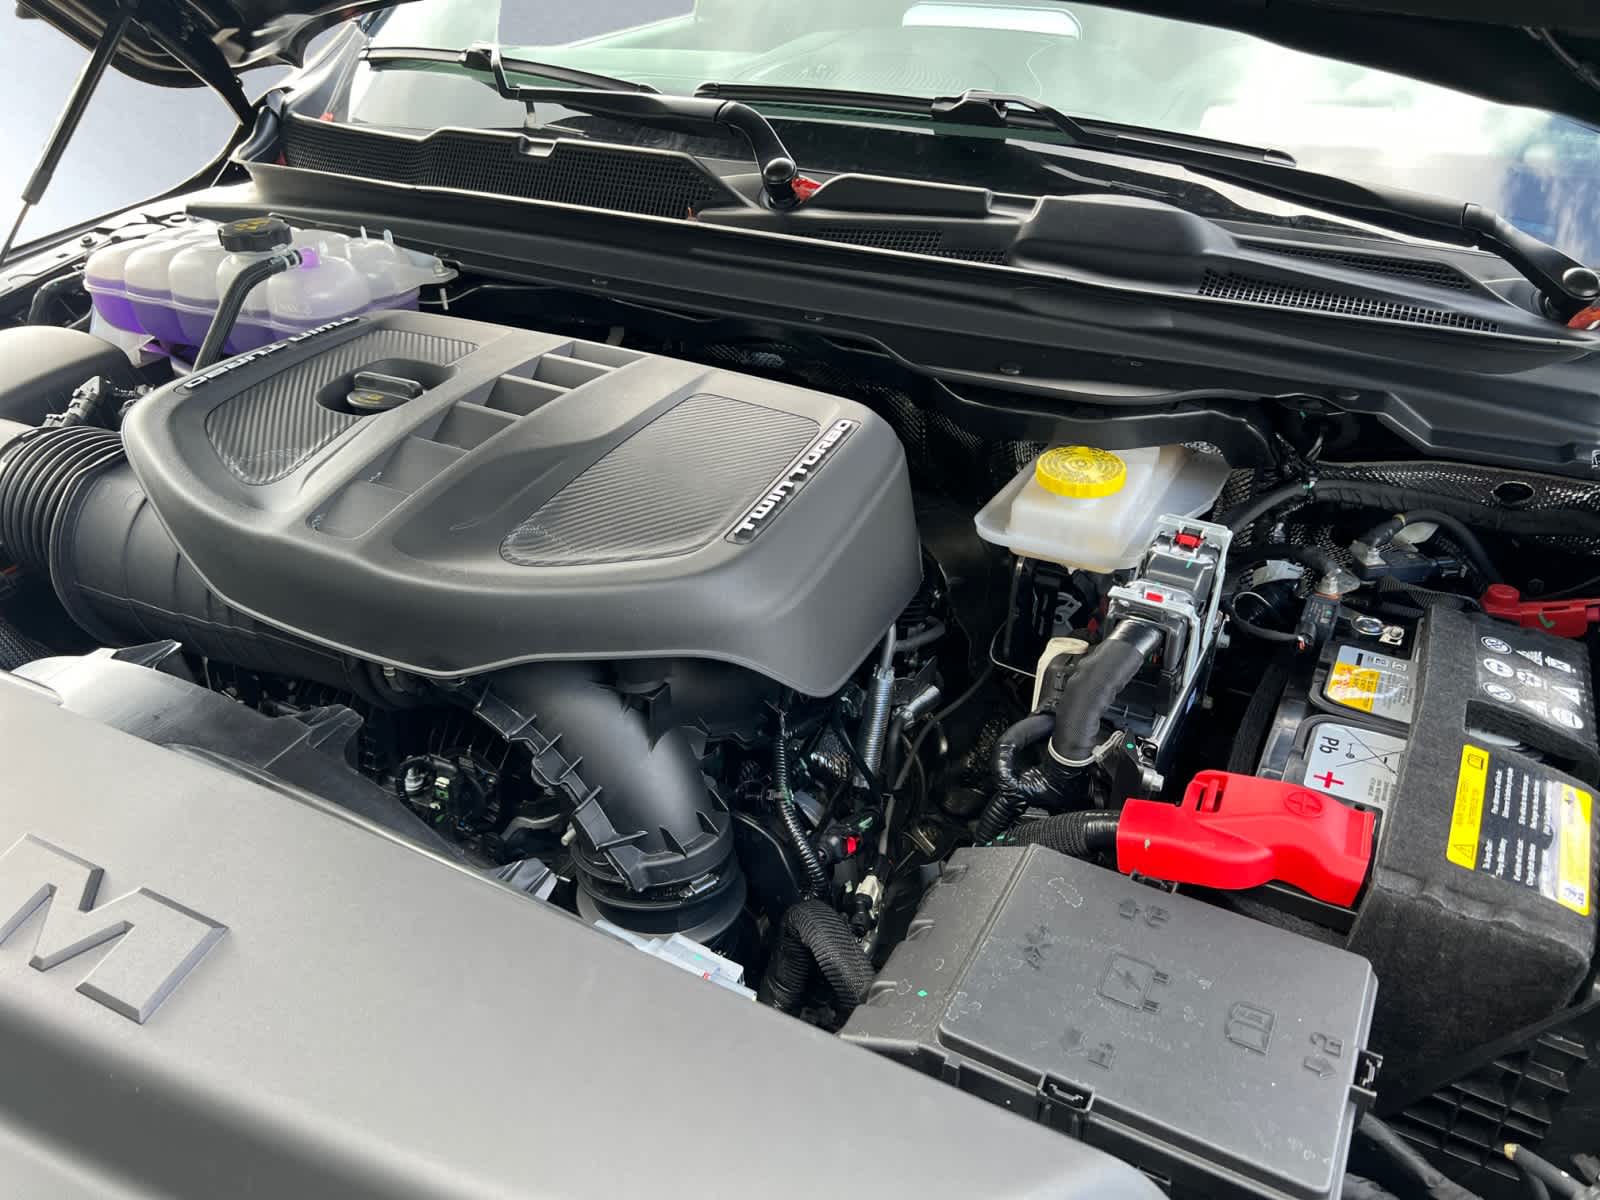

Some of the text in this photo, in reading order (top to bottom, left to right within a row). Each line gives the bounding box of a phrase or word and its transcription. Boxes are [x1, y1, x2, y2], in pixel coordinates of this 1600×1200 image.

[184, 316, 360, 389] TWIN TURBO
[734, 419, 853, 536] TWIN TURBO
[1319, 735, 1339, 754] Pb
[0, 833, 229, 1025] M
